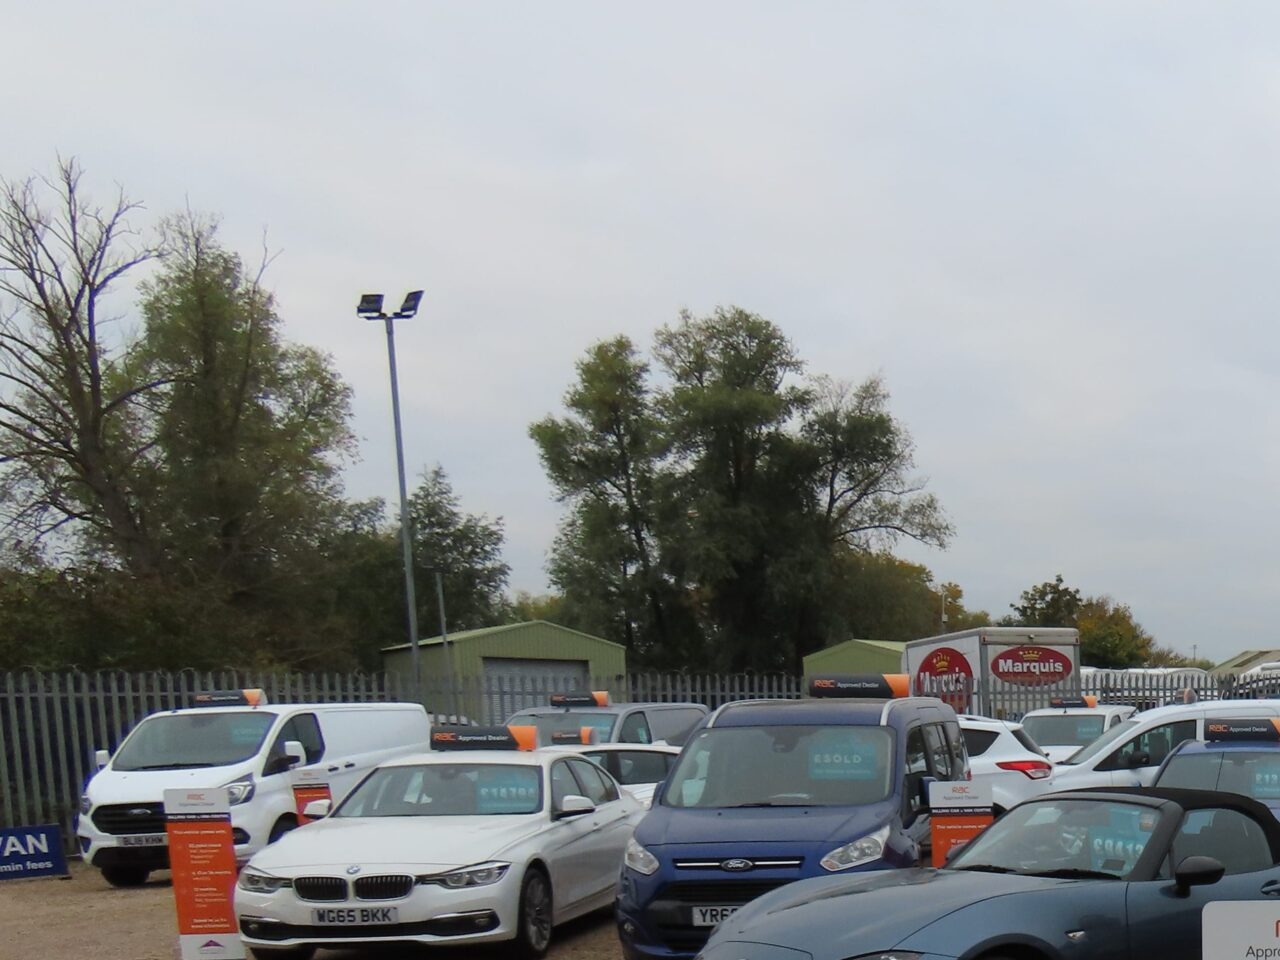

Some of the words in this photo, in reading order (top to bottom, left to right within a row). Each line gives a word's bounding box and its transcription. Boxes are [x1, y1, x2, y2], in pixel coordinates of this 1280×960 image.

[999, 659, 1063, 675] Marquis
[0, 833, 49, 857] AN
[26, 861, 54, 870] fees
[316, 909, 356, 923] WG65
[361, 908, 392, 922] BKK
[699, 908, 738, 923] YR6
